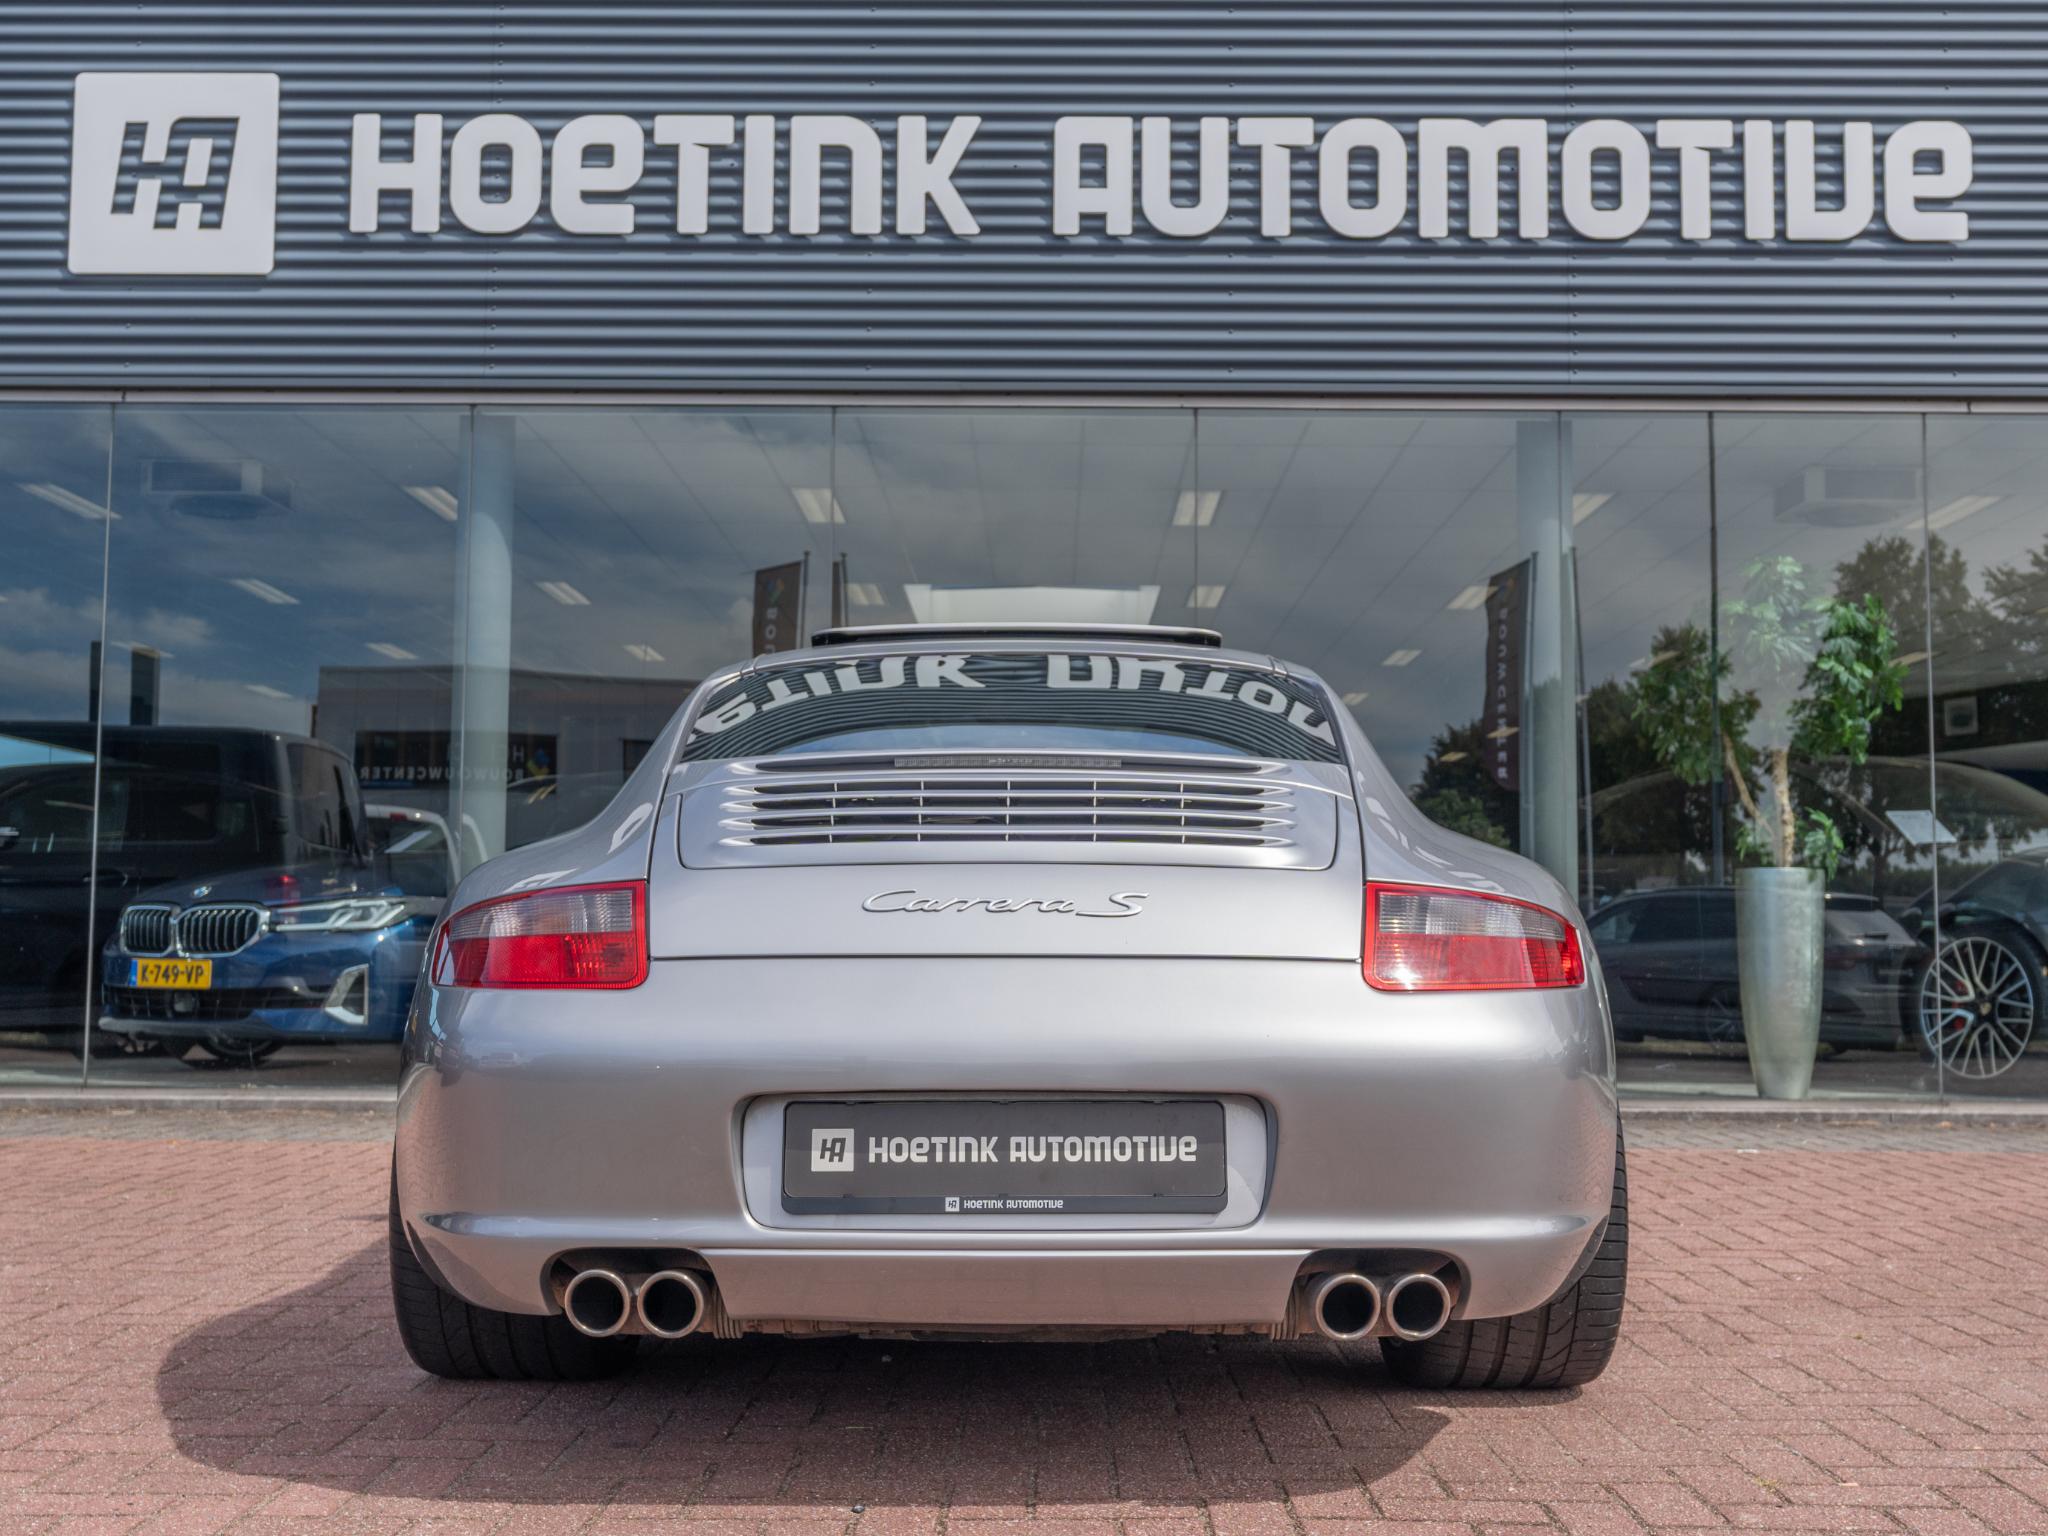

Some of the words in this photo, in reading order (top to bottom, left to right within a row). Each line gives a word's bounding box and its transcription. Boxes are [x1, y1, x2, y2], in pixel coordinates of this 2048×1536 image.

[1053, 116, 1973, 240] AUTOMOTIVE
[862, 889, 1075, 913] Carrera
[1075, 892, 1149, 918] S
[141, 964, 204, 983] K-749-VP
[1009, 1135, 1198, 1163] AUTOMOTIVE
